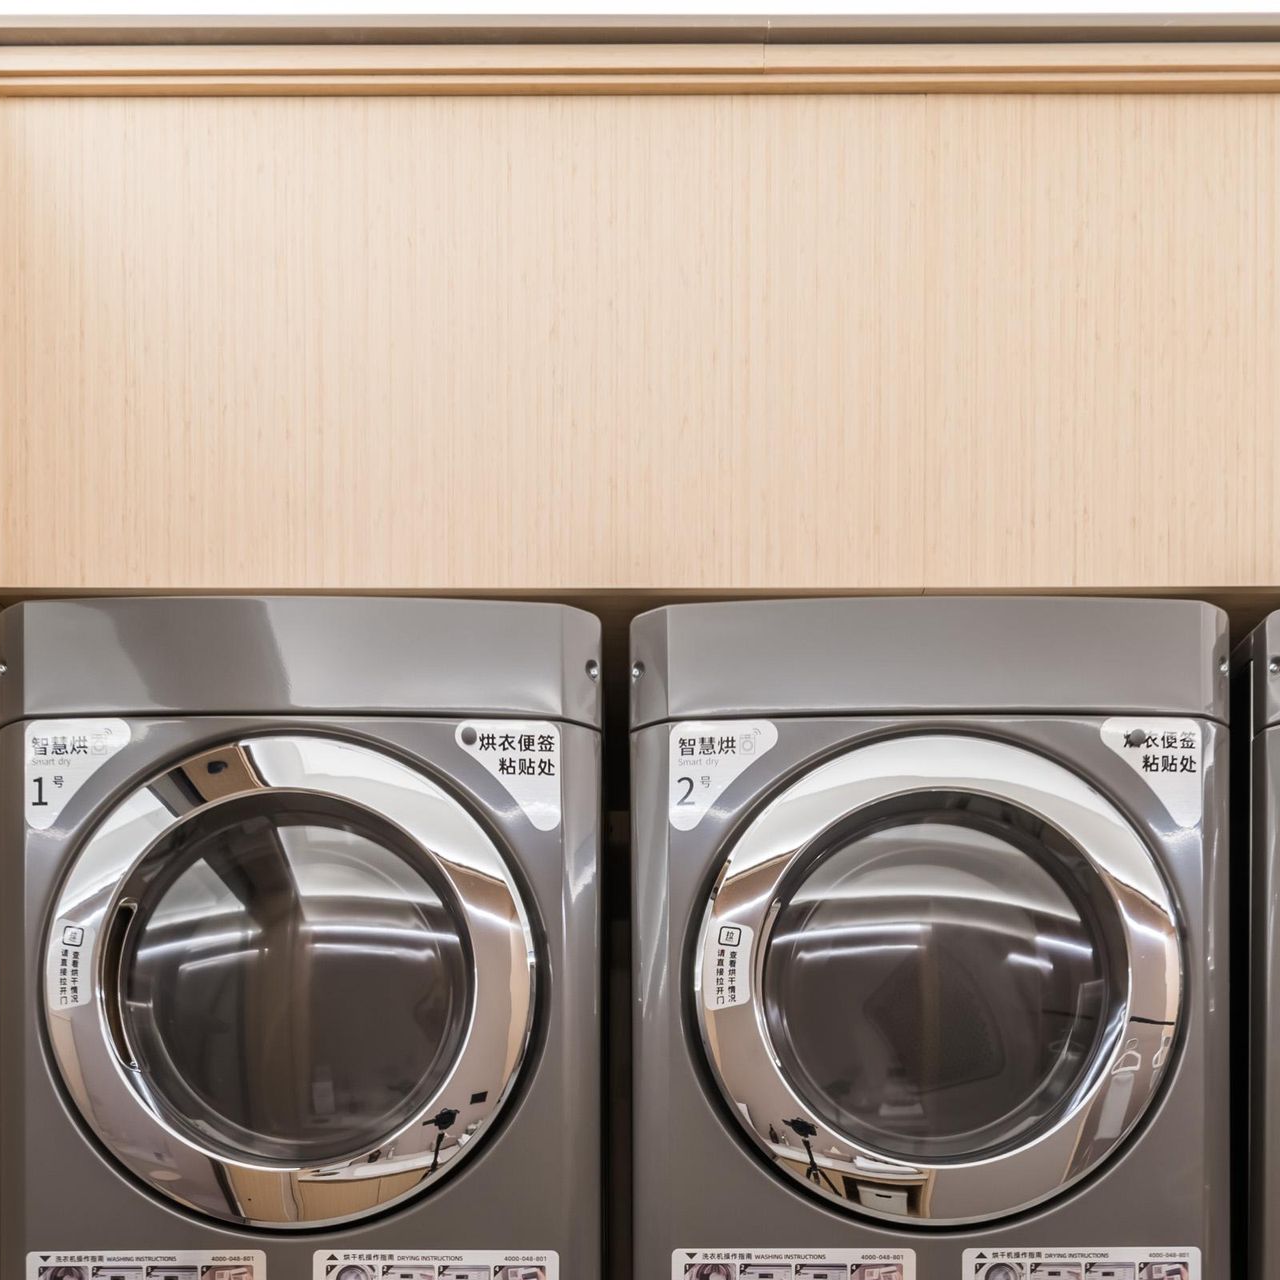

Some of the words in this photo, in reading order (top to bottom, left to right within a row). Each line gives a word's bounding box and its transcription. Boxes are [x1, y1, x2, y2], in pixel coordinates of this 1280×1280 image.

[32, 736, 88, 755] 智慧烘
[479, 733, 555, 752] 烘衣便签
[678, 737, 737, 756] 智慧烘
[32, 758, 55, 767] Smart
[58, 757, 72, 767] dry
[499, 758, 555, 776] 粘贴处
[678, 758, 702, 766] Smart
[706, 757, 719, 768] dry
[1142, 754, 1197, 773] 粘贴处
[716, 949, 725, 1005] 请直接拉开门
[728, 951, 737, 1003] 查看烘干情况
[343, 1253, 395, 1261] 烘干机操作指南
[991, 1251, 1043, 1259] 烘干机操作指南
